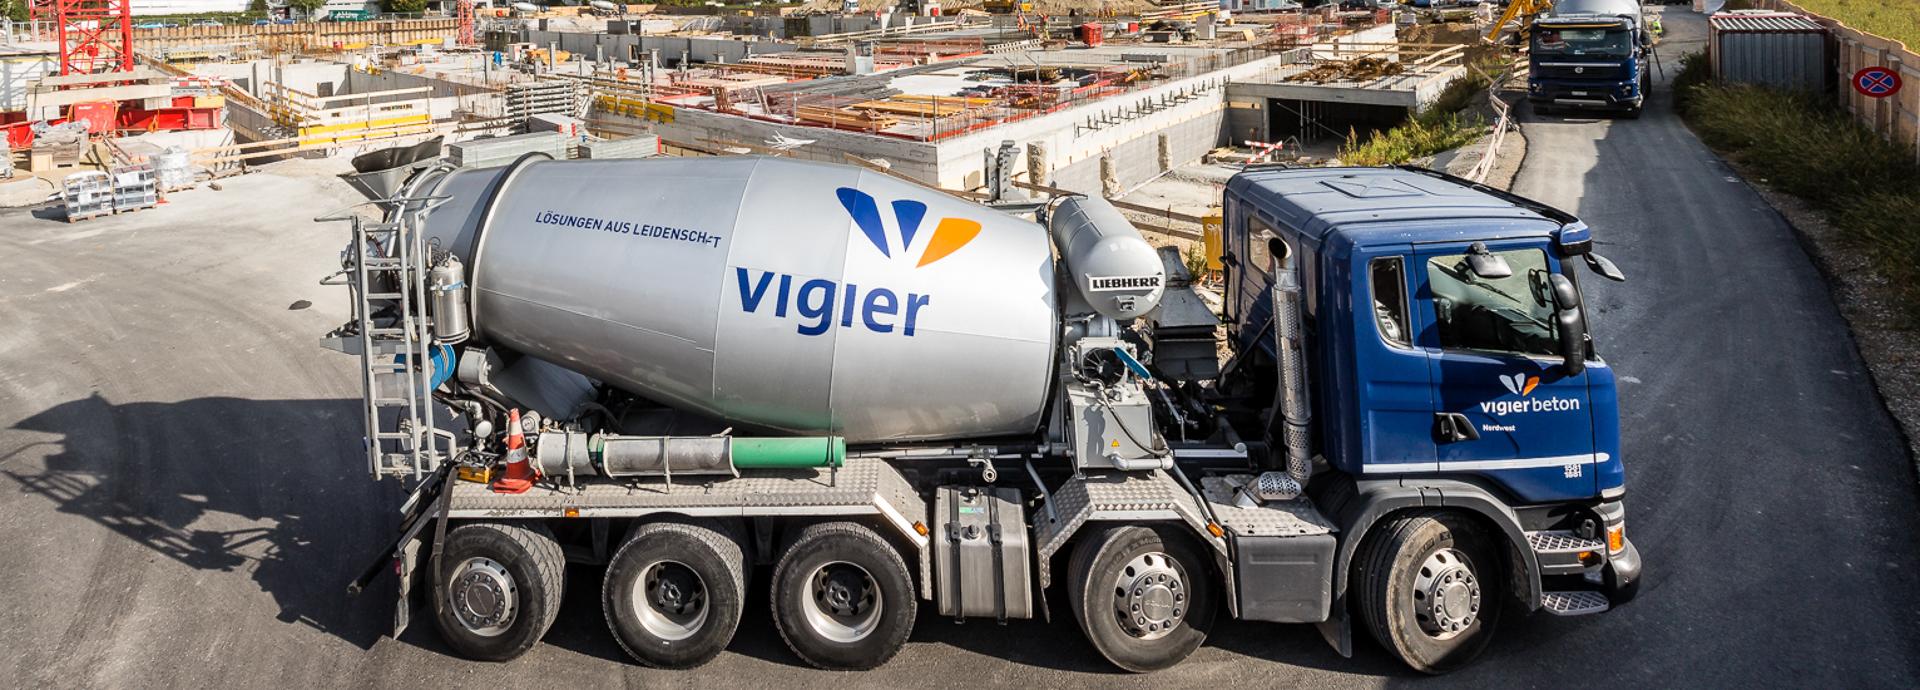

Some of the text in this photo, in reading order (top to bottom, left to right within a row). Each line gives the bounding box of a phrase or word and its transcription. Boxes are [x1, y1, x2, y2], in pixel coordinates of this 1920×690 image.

[535, 210, 603, 231] LÖSUNGEN
[604, 220, 630, 234] AUS
[1092, 277, 1160, 289] LIEBHERR
[736, 266, 930, 337] vigier
[1480, 396, 1580, 416] vigier beton
